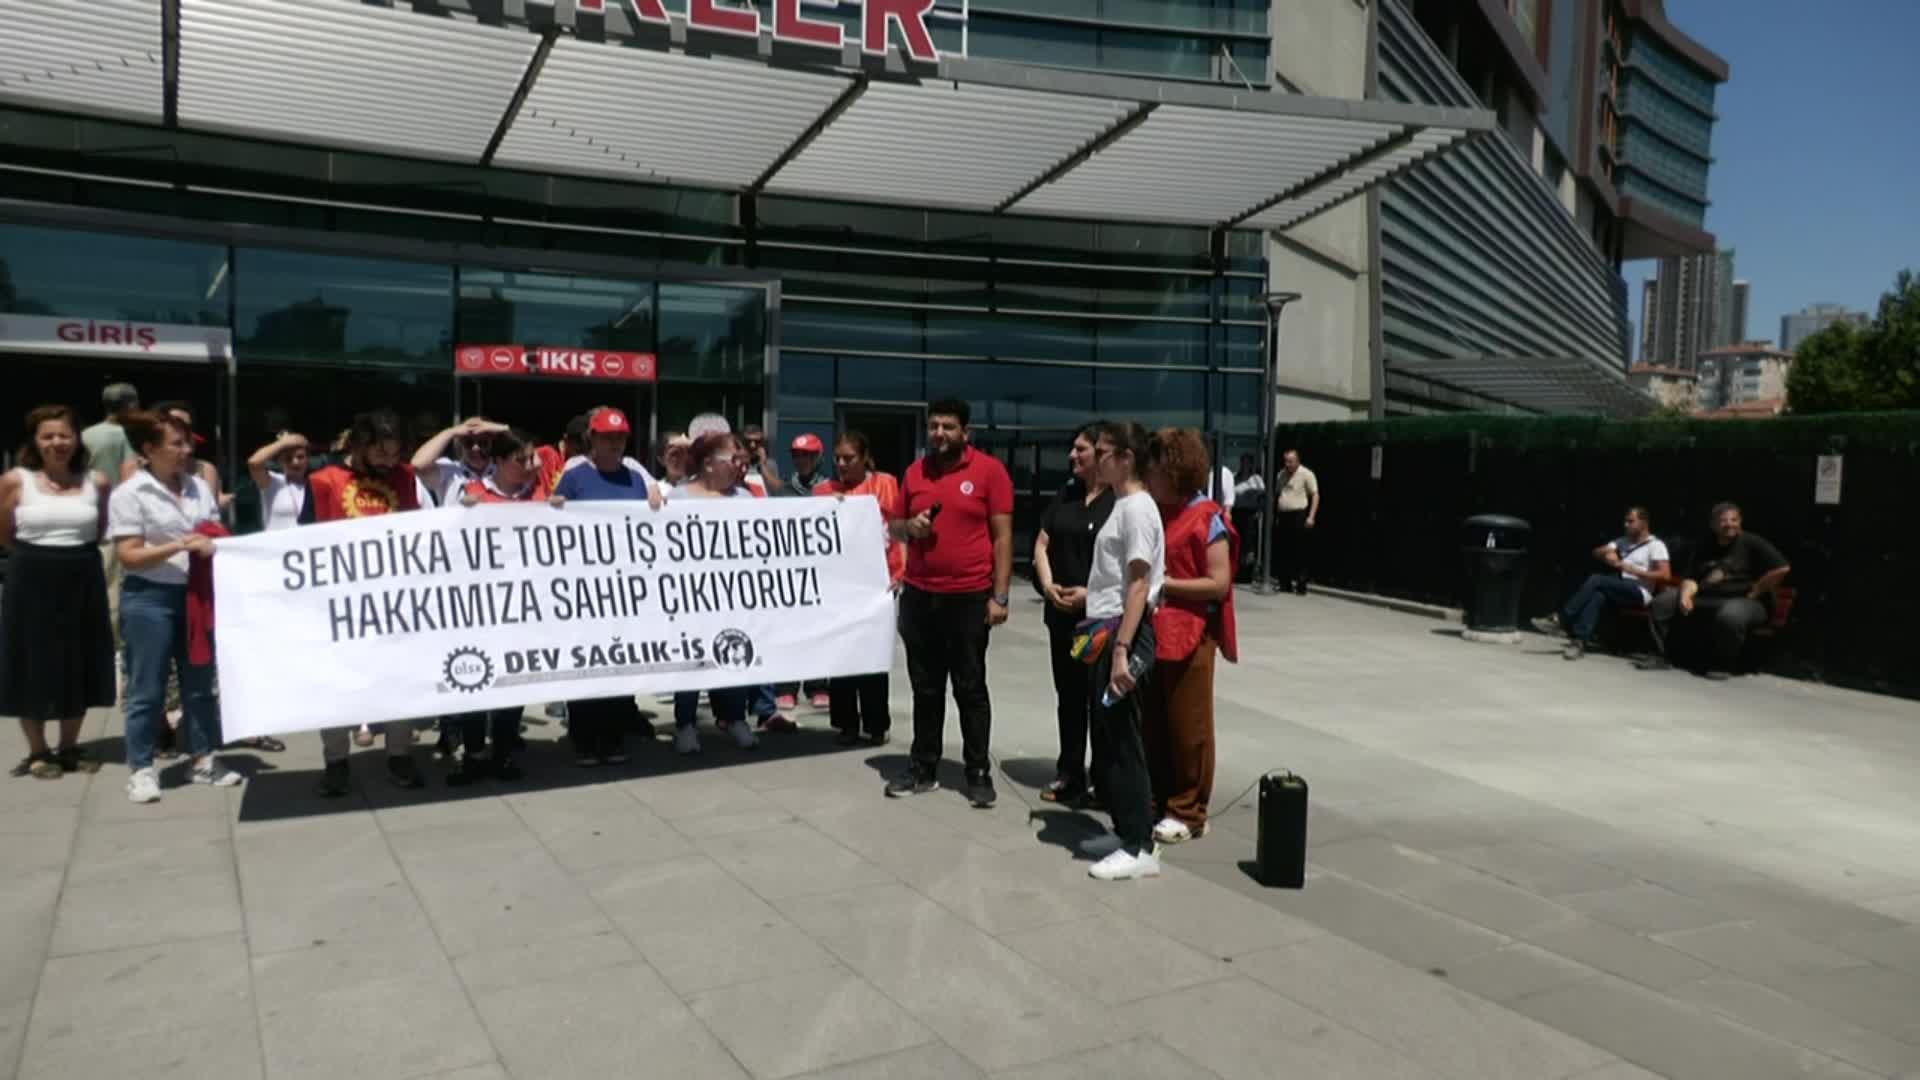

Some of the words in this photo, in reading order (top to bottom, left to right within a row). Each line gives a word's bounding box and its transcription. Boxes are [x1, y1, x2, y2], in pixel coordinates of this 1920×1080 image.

[57, 320, 157, 351] GİRİŞ
[520, 350, 595, 375] ÇIKIŞ
[282, 529, 451, 591] SENDİKA
[460, 527, 504, 571] VE
[512, 523, 616, 568] TOPLU
[624, 515, 657, 569] İŞ
[665, 510, 842, 564] SÖZLEŞMESİ
[328, 579, 542, 642] HAKKIMIZA
[551, 568, 648, 620] SAHİP
[658, 567, 822, 622] ÇIKIYORUZ!
[504, 648, 560, 674] DEV
